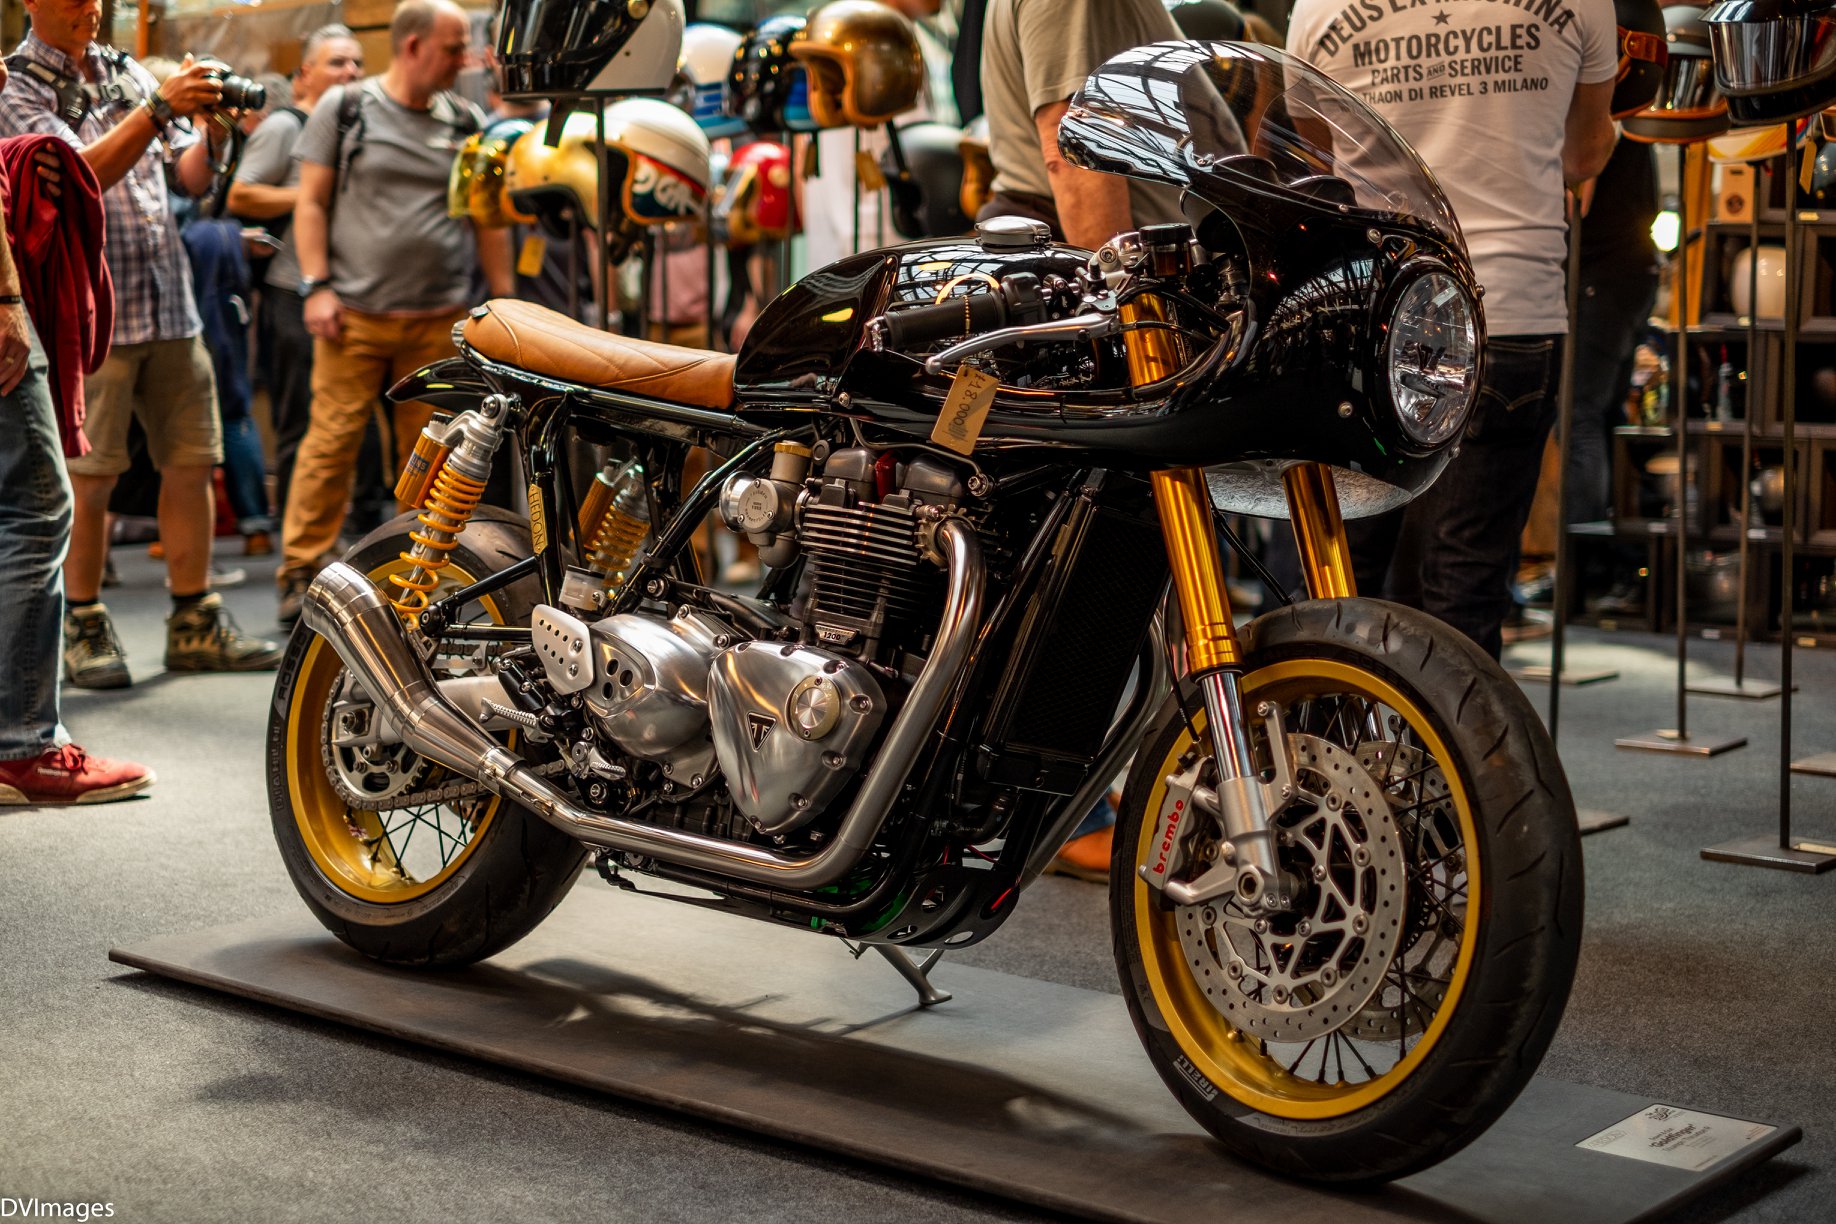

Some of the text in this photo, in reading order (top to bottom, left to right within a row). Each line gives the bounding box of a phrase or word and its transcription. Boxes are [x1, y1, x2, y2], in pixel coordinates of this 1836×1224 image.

[1318, 0, 1383, 57] DEUS
[1353, 23, 1541, 68] MOTORCYCLES
[1371, 55, 1523, 87] PARTS AND SERVICE
[1408, 87, 1424, 101] DI
[1429, 83, 1474, 99] REVEL
[1479, 81, 1488, 95] 3
[1493, 77, 1548, 94] MILANO
[529, 492, 543, 546] HEDON
[823, 631, 841, 641] 1200
[278, 631, 308, 701] ROSSO
[1153, 800, 1184, 874] brembo
[1173, 1055, 1218, 1101] PIRELLI
